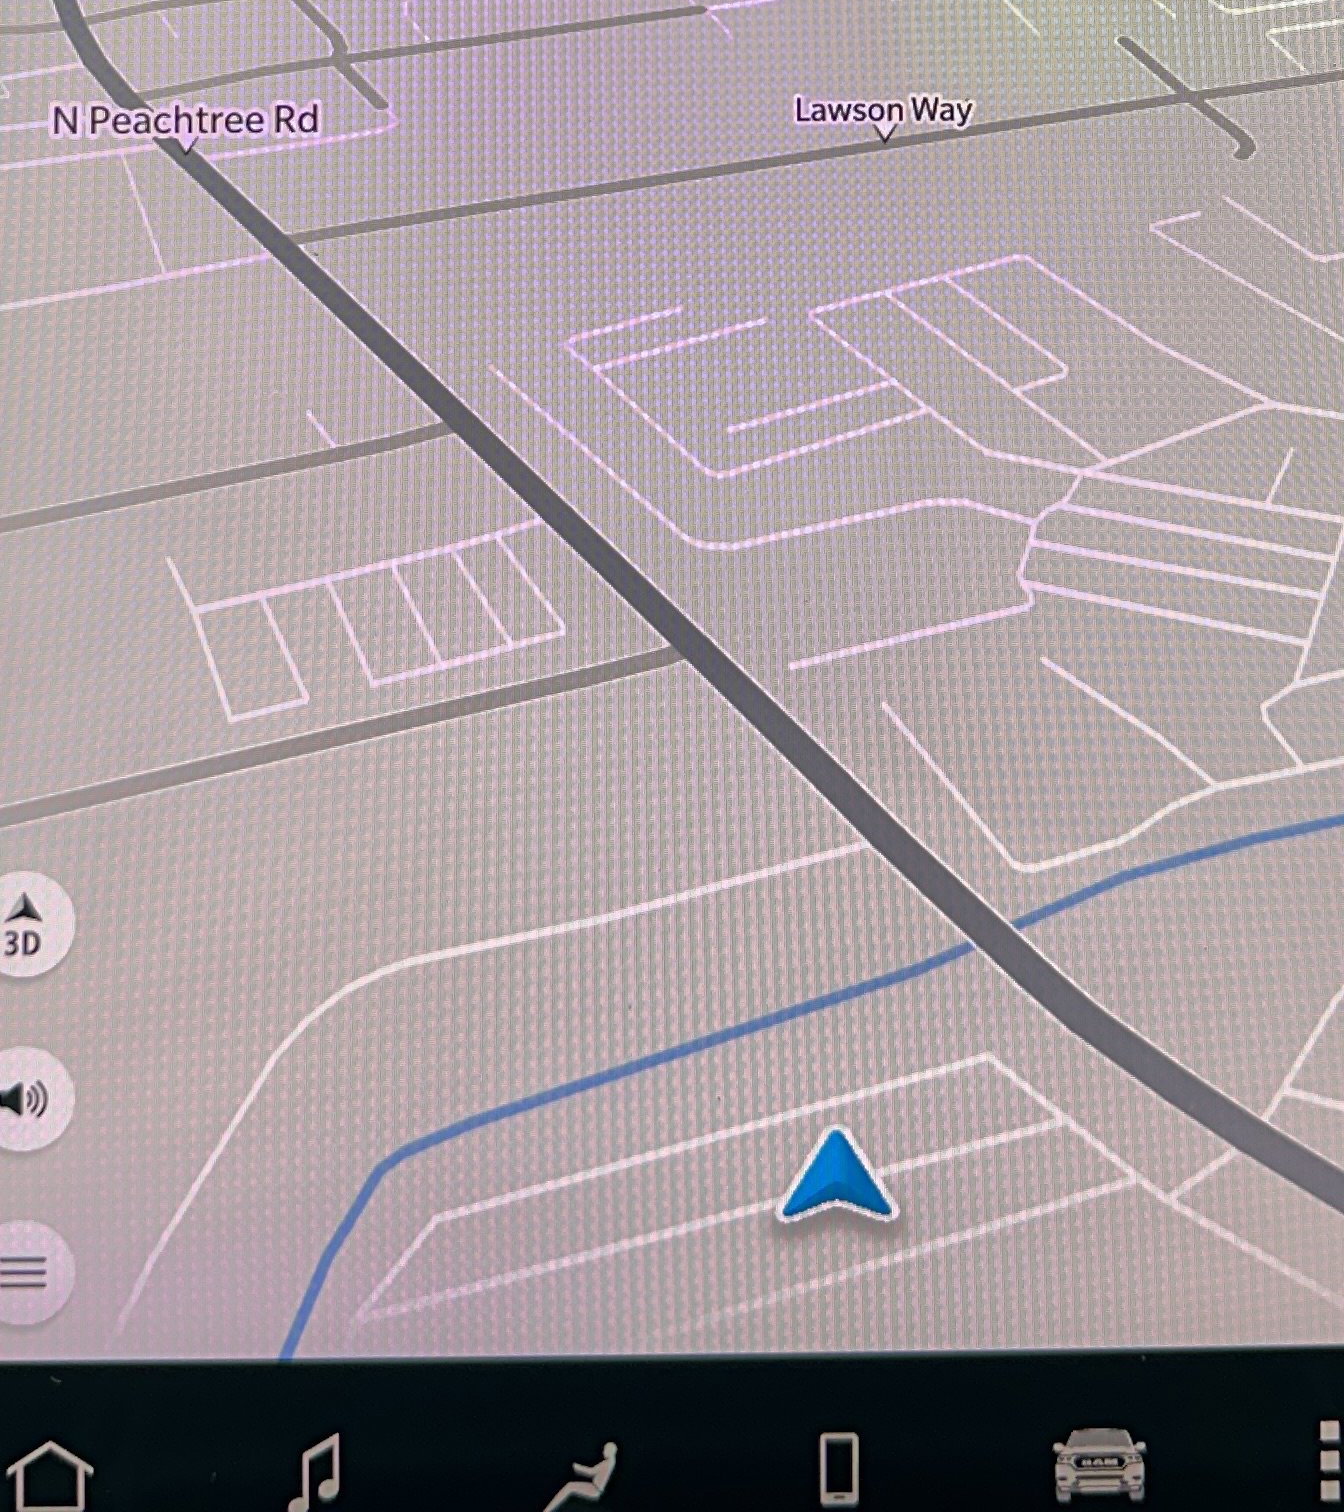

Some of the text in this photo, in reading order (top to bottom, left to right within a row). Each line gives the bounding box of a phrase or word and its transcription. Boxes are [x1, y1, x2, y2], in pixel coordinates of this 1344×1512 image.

[53, 104, 319, 135] N Peachtree Rd
[796, 98, 973, 129] Lawson Way
[4, 930, 41, 957] 3D
